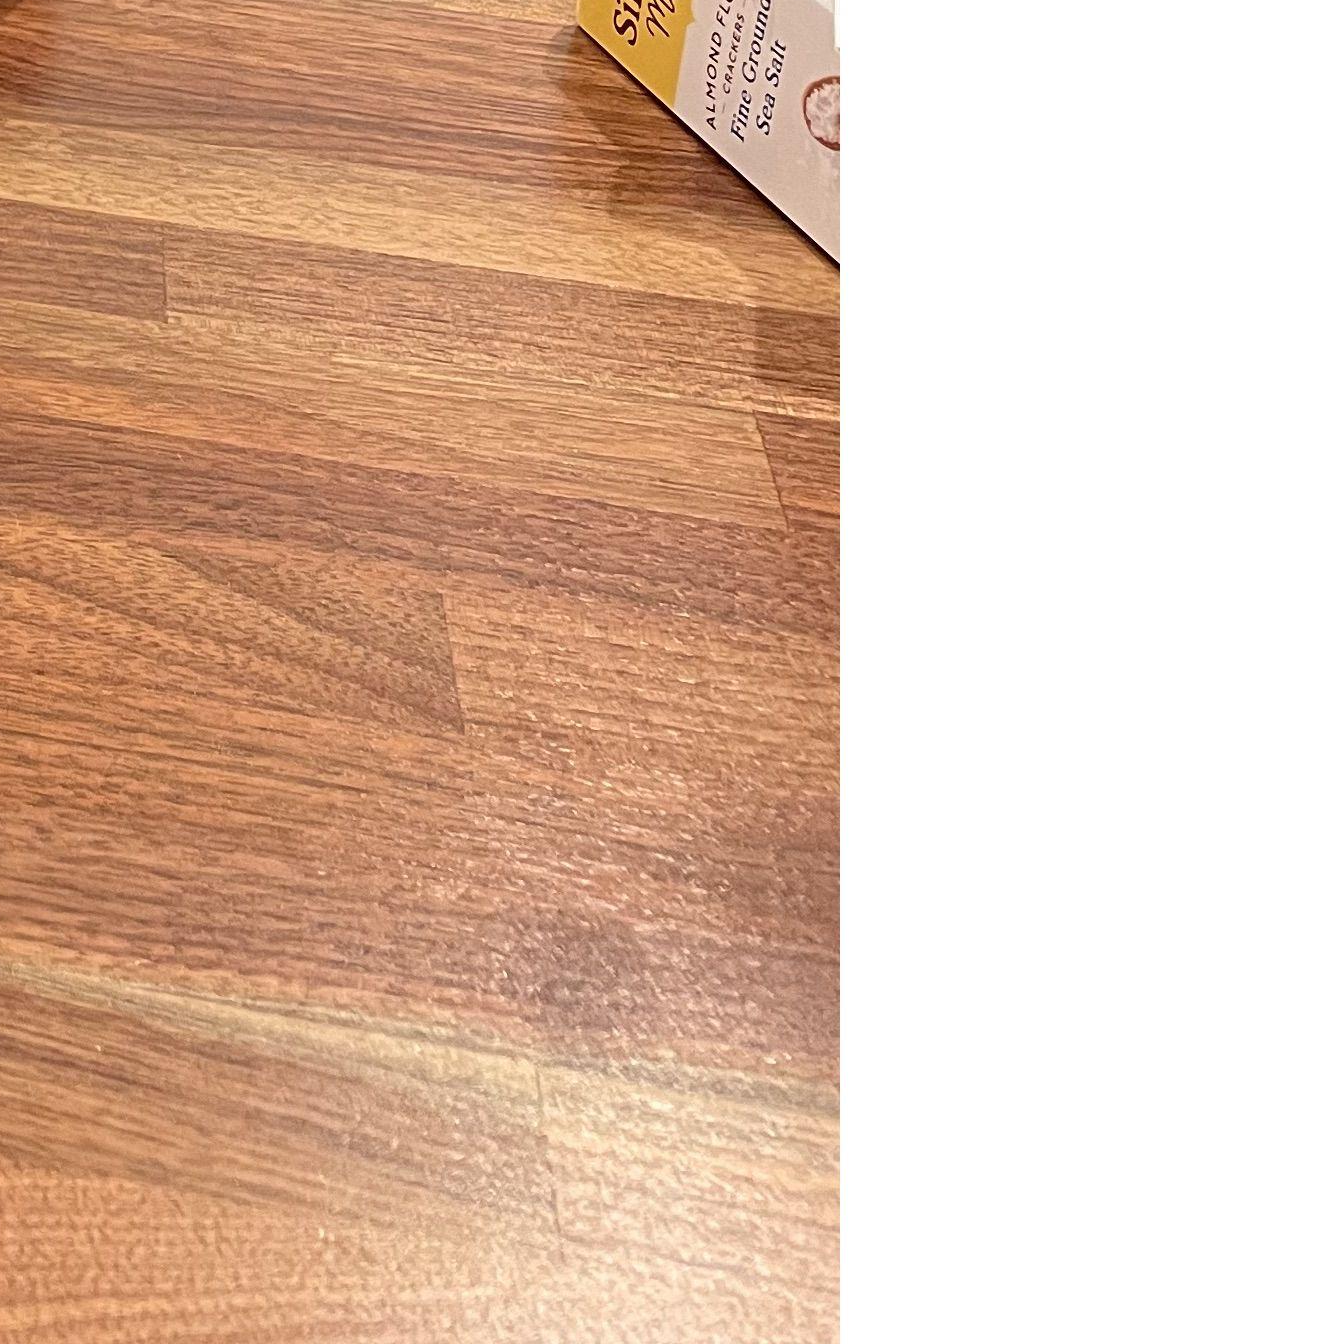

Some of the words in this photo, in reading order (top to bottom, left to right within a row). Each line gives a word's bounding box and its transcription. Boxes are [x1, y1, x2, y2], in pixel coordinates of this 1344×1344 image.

[705, 30, 723, 131] ALMOND
[722, 12, 746, 95] CRACKERS
[764, 38, 787, 88] Salt
[730, 88, 753, 143] Fine
[755, 92, 776, 136] Sea
